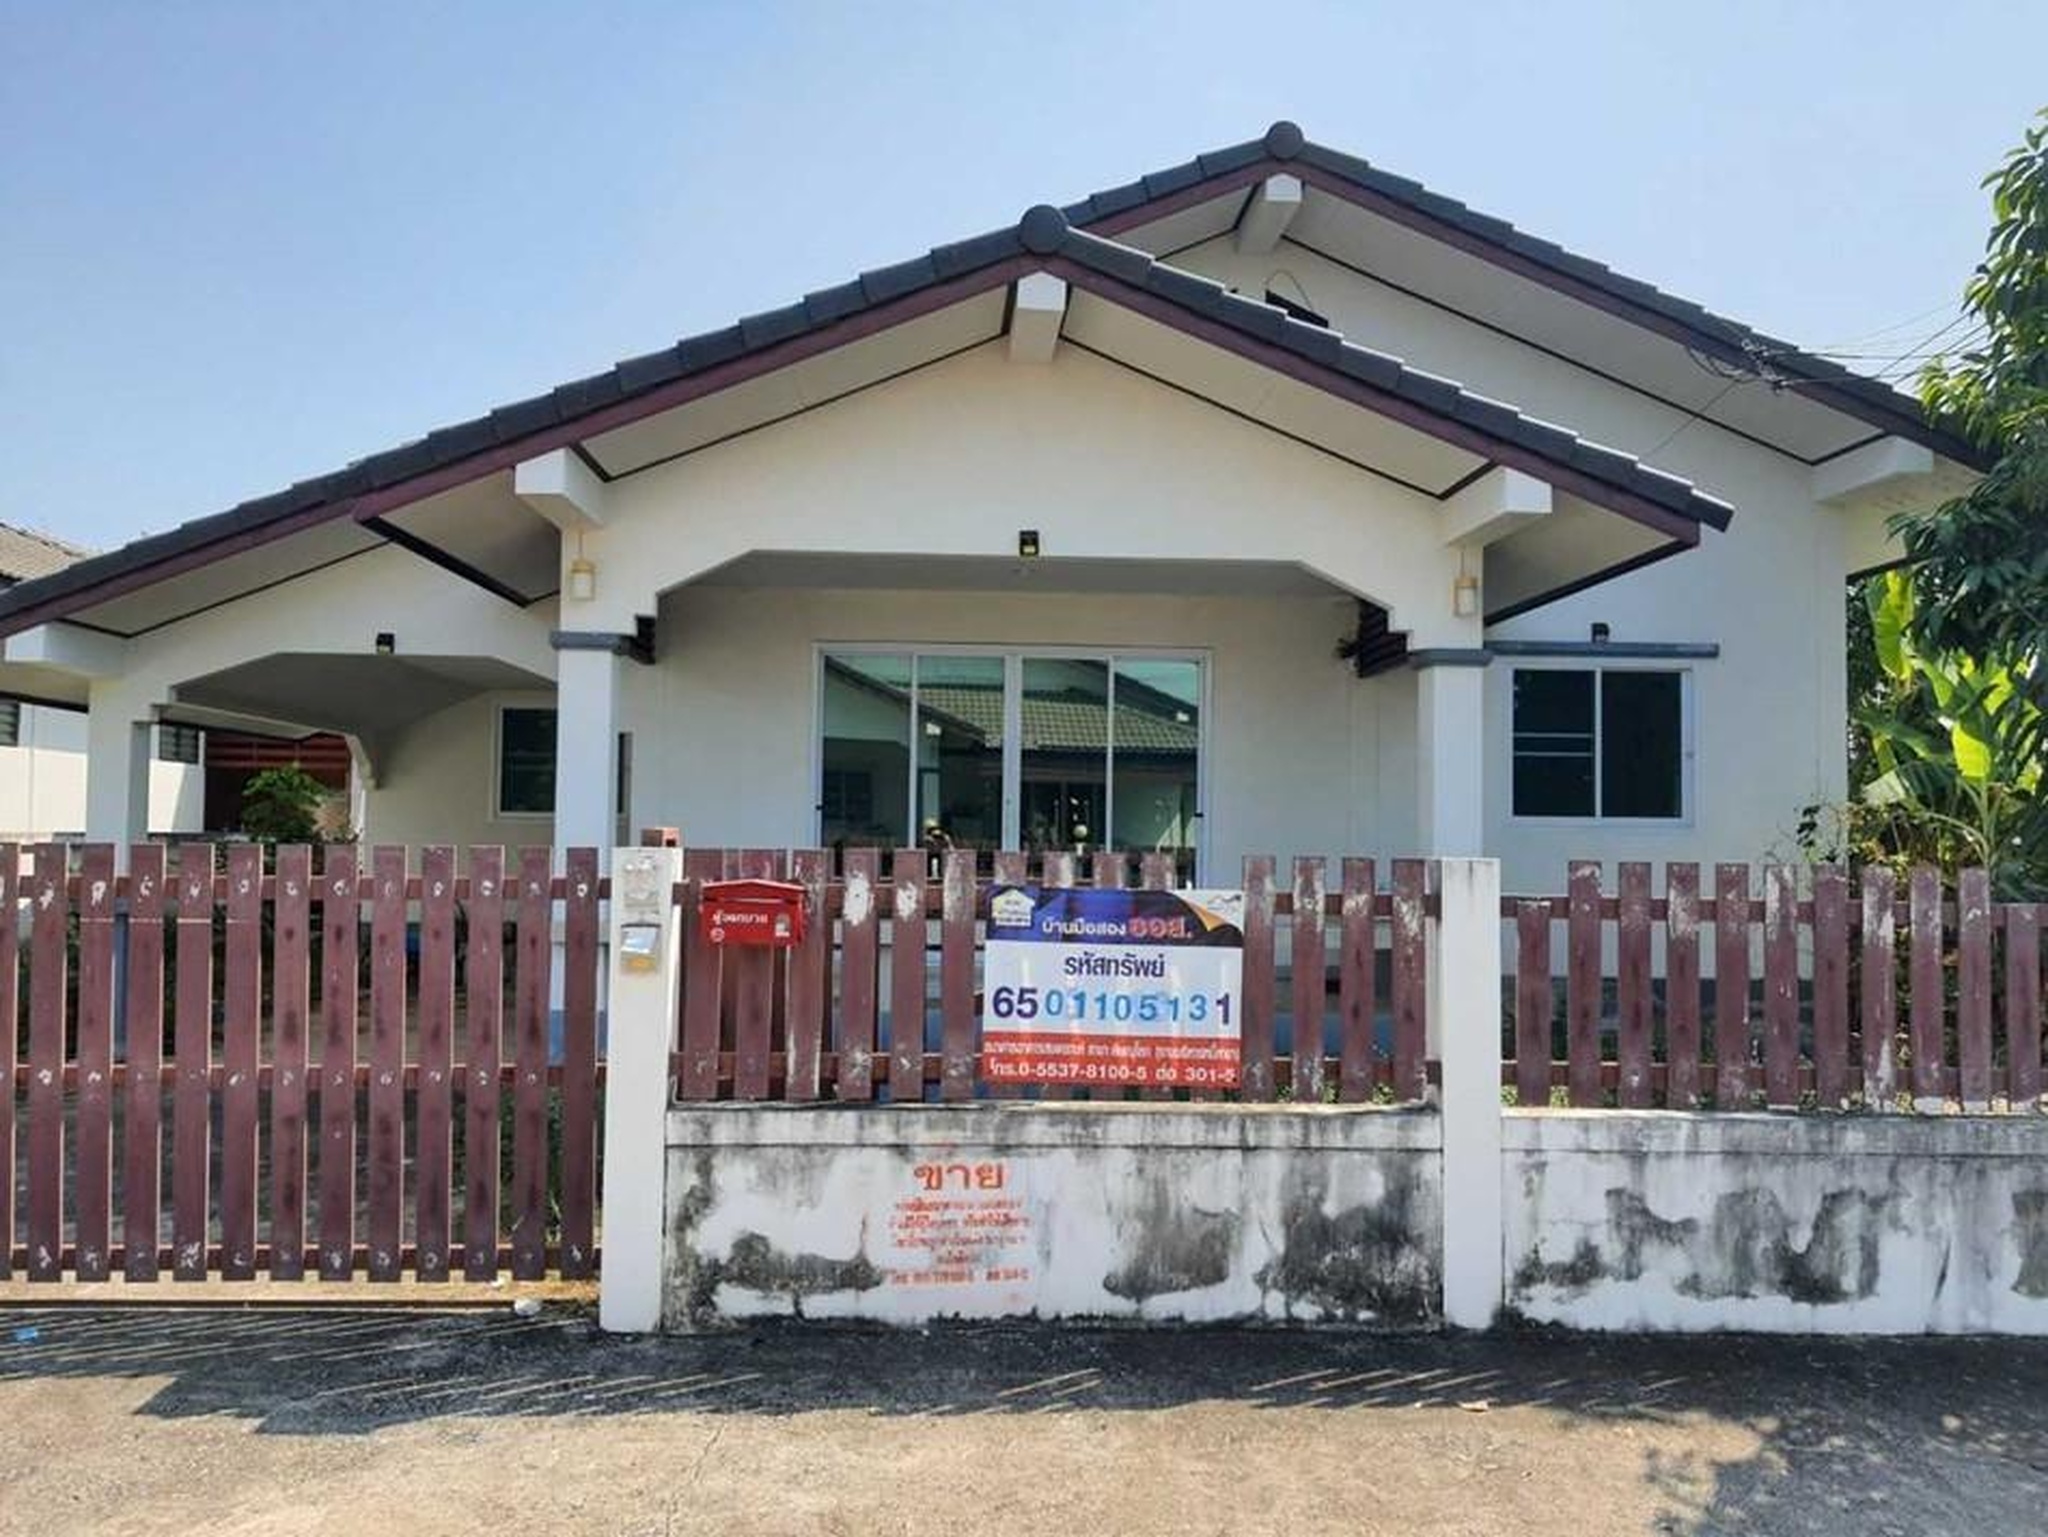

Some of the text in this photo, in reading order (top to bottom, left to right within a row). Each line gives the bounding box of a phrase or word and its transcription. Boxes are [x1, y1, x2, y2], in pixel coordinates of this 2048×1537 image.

[1041, 914, 1126, 936] บ้านมือสอง
[1064, 950, 1166, 978] รหัสทรัพย์
[913, 1160, 1004, 1191] ขาย
